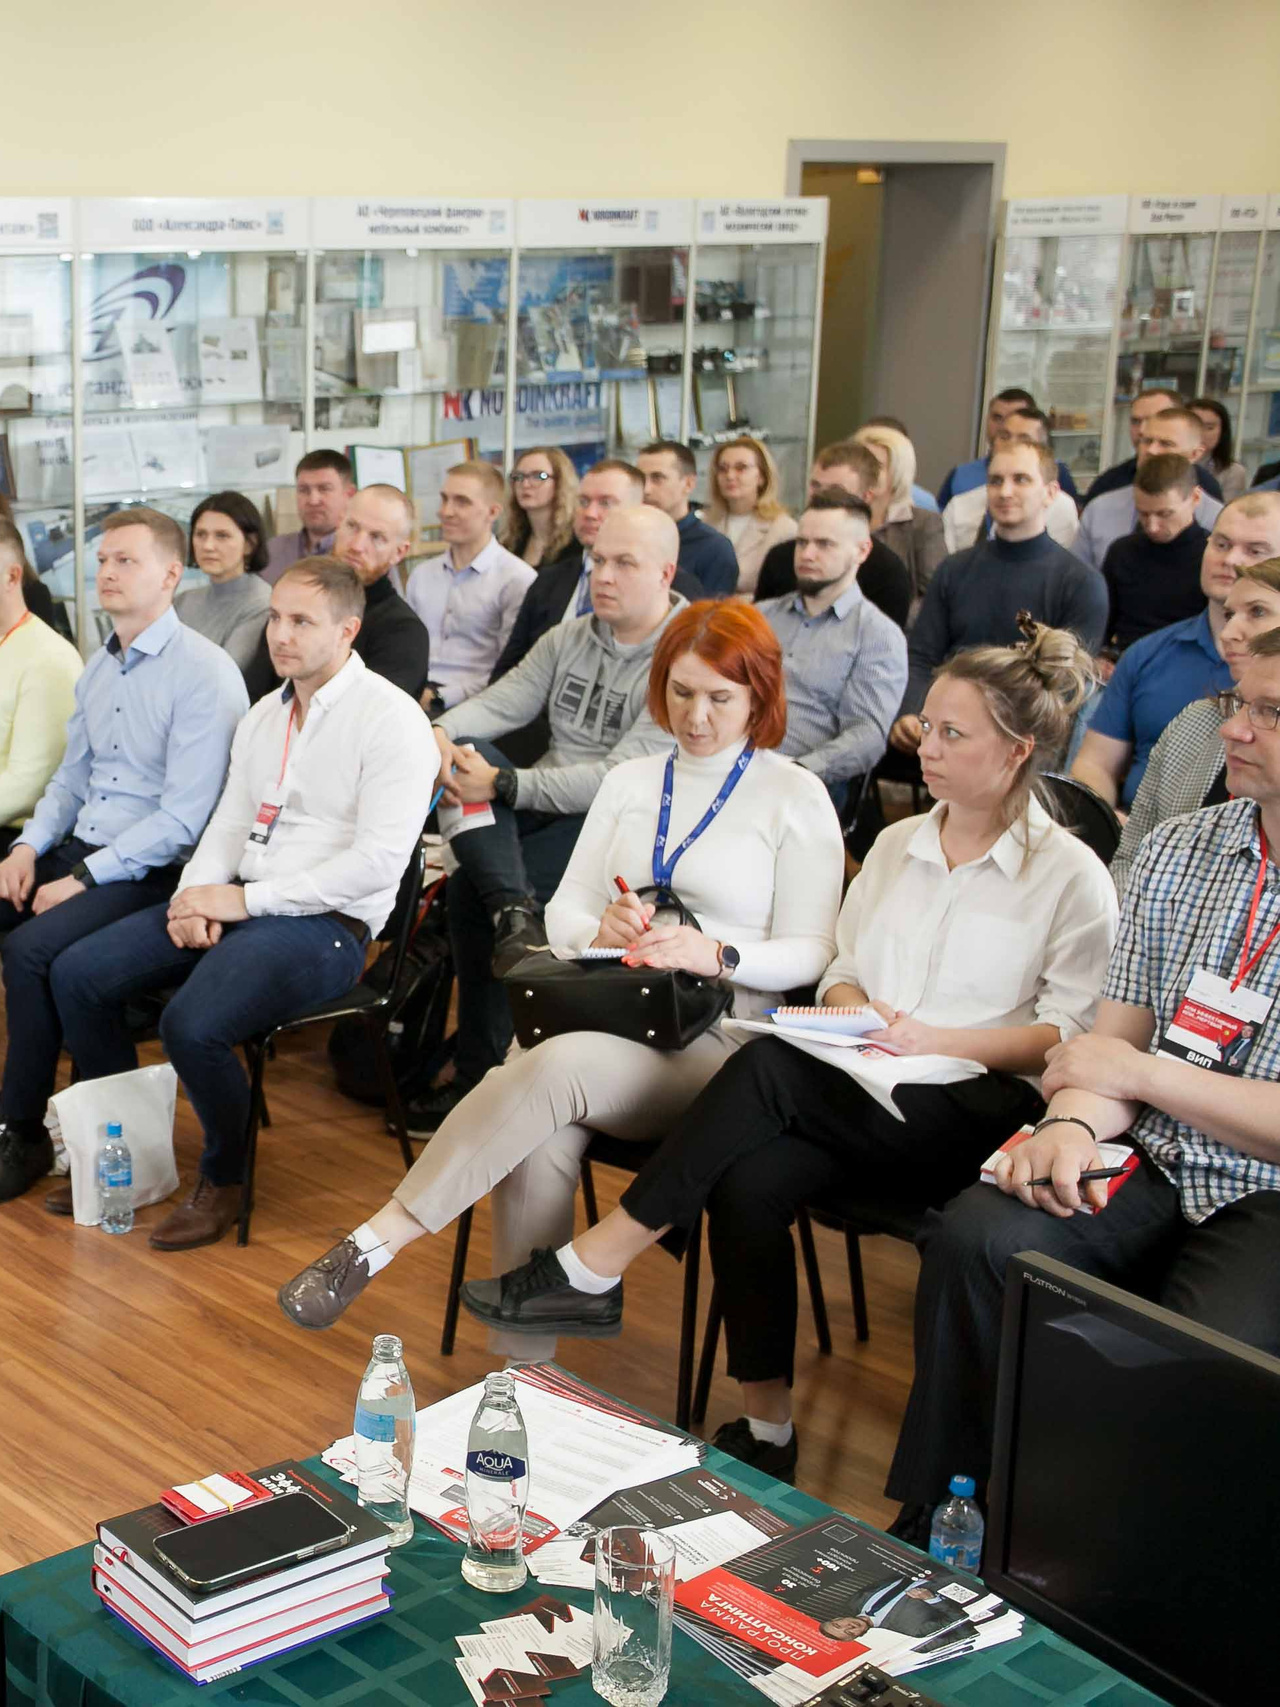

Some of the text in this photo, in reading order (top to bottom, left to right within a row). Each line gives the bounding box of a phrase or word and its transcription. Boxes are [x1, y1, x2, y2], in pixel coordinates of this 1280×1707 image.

[1186, 1050, 1213, 1069] ВИП
[476, 1452, 513, 1471] AQUA
[479, 1466, 510, 1476] MINERALE
[816, 1557, 840, 1572] 160+
[781, 1578, 798, 1589] 30
[700, 1599, 806, 1661] ПРОГРАММА
[708, 1592, 818, 1656] КОНСАЛТИНГА
